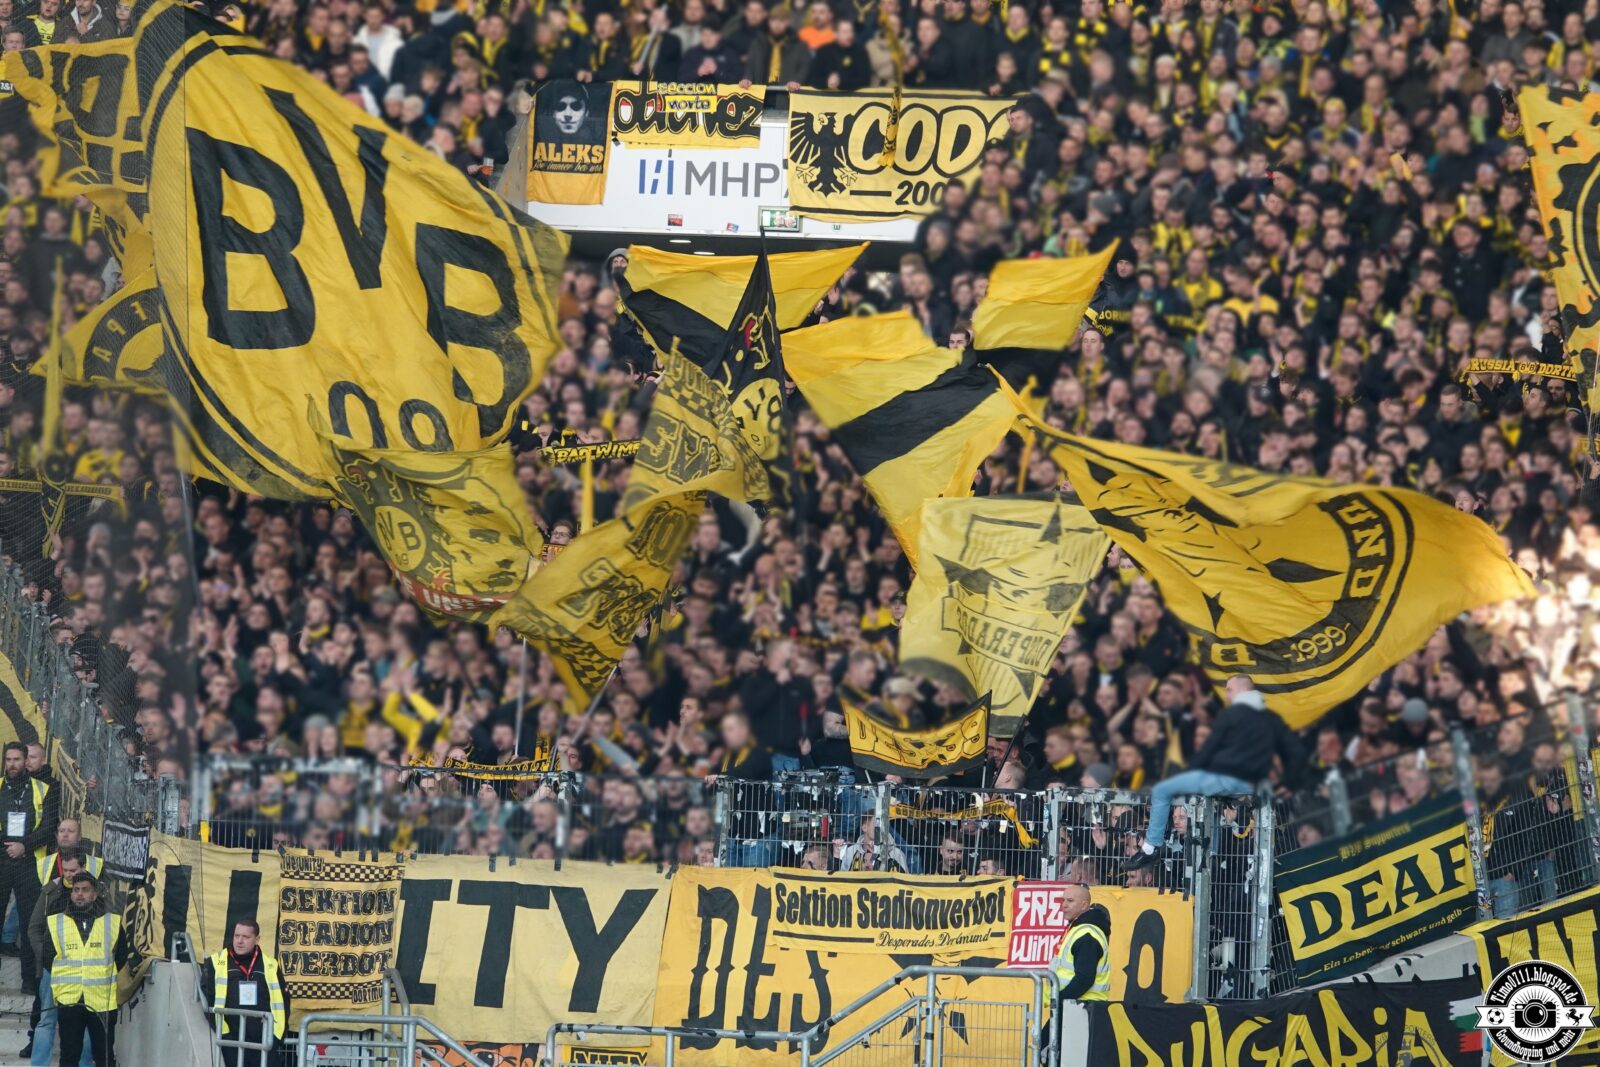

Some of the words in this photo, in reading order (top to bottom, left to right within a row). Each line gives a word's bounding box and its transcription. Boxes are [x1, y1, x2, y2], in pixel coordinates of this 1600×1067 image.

[668, 96, 711, 110] norte
[534, 142, 604, 164] ALEKS
[685, 160, 789, 198] MHP
[187, 86, 532, 438] BVB
[280, 886, 397, 915] SEKTION
[775, 882, 853, 929] Sektion
[857, 885, 1006, 931] Stadionverbot
[1015, 890, 1069, 927] FRE
[1288, 834, 1469, 949] DEAF
[279, 918, 394, 947] STADION
[876, 930, 935, 950] Desperados
[935, 928, 992, 947] Dortmund
[1323, 960, 1341, 972] Ein
[1391, 926, 1428, 947] schwarz
[1428, 917, 1448, 931] und
[1446, 908, 1463, 927] gelb
